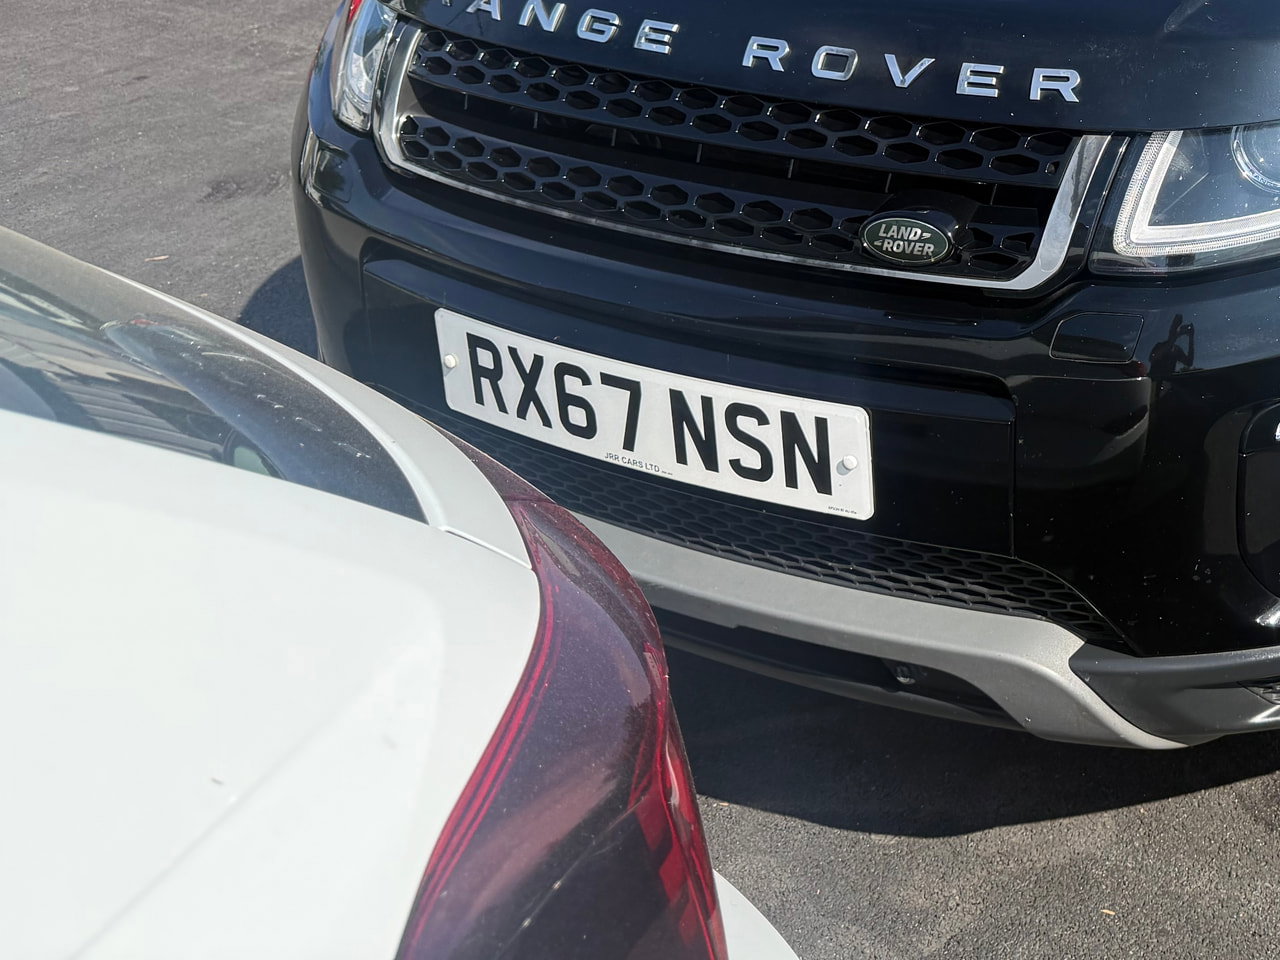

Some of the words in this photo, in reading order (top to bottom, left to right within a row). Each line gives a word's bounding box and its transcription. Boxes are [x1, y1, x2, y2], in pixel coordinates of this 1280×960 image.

[742, 35, 1082, 102] ROVER
[879, 223, 922, 240] LAND
[882, 239, 934, 256] ROVER
[466, 332, 642, 452] RX67
[669, 388, 833, 496] NSN
[605, 452, 619, 462] JRR
[621, 456, 643, 468] CARS
[645, 462, 660, 472] LTD
